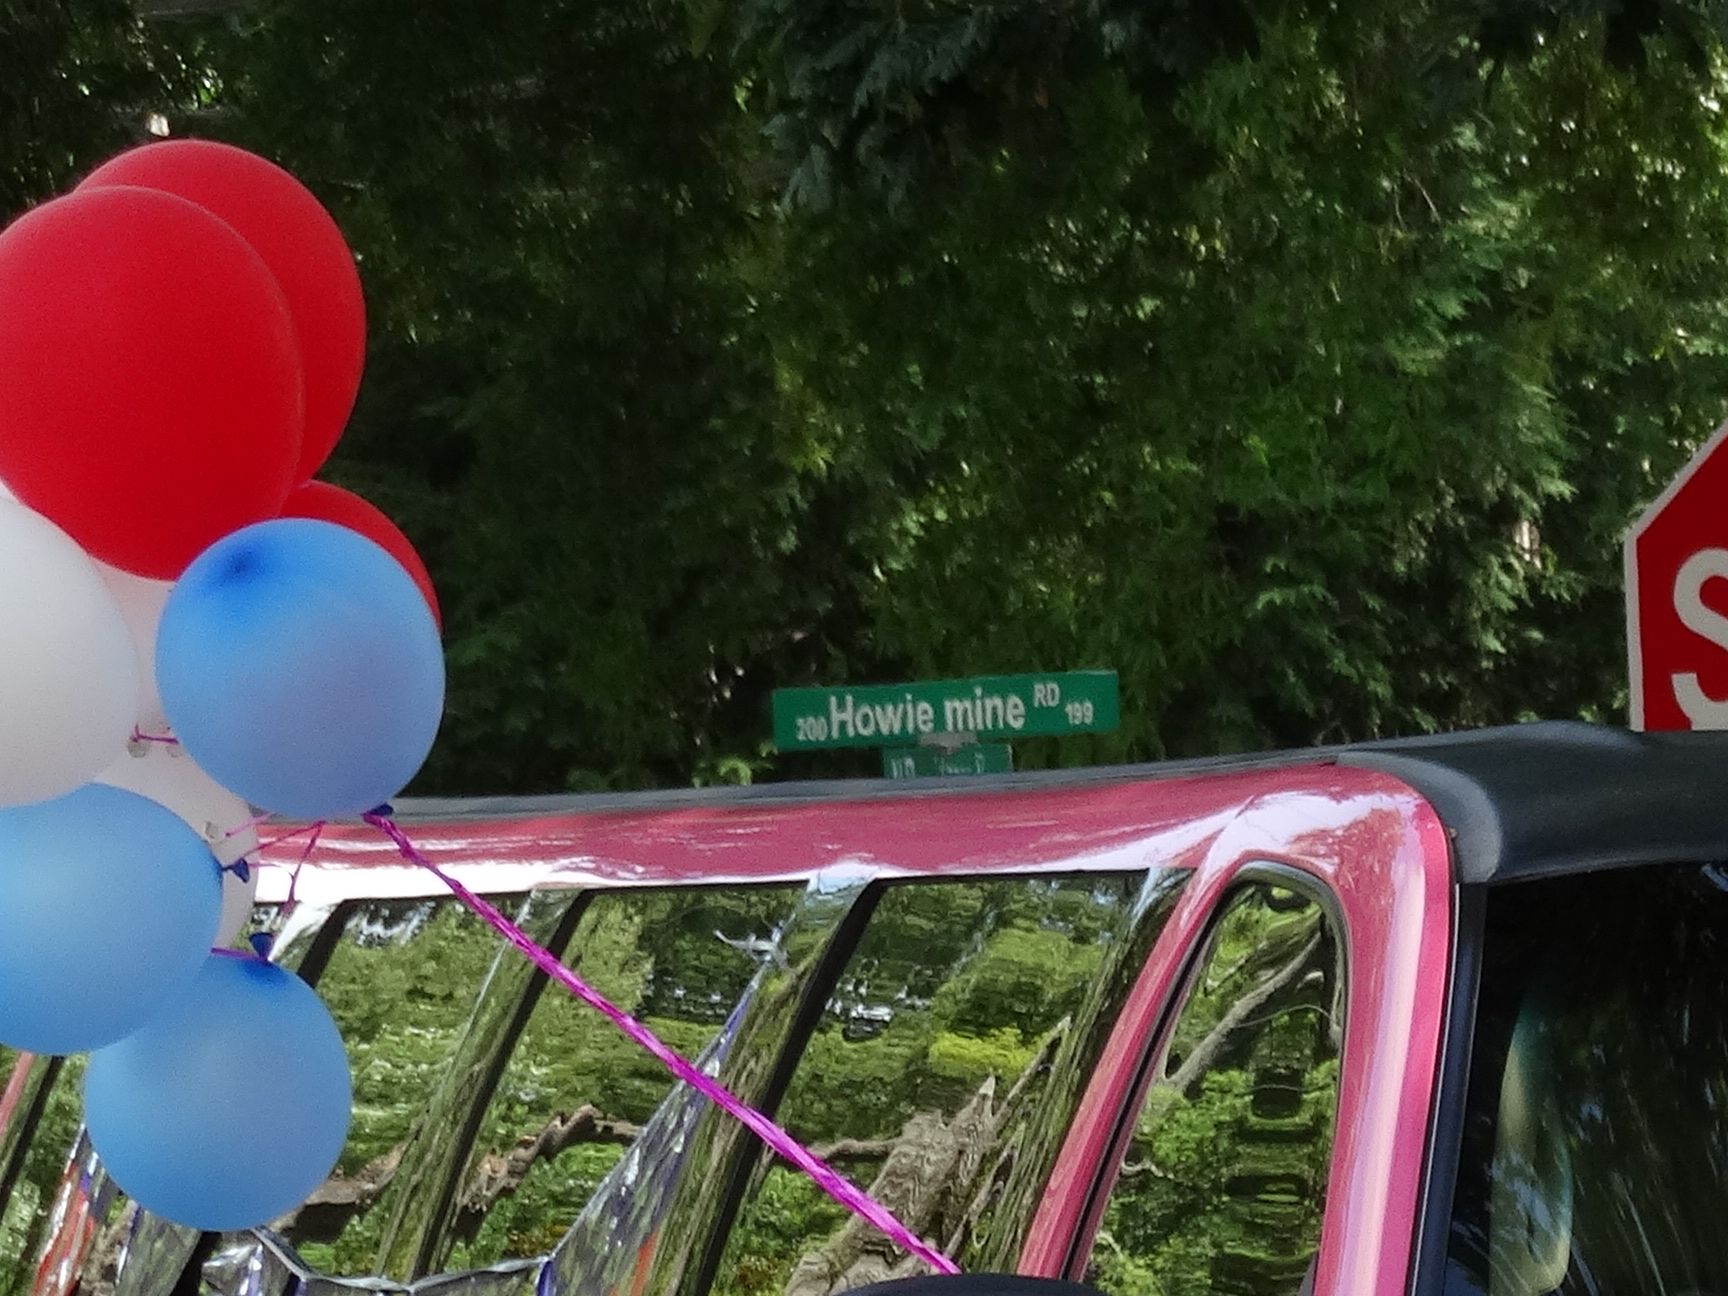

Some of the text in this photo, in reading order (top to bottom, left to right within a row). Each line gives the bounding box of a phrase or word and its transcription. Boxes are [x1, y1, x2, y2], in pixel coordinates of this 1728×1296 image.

[796, 682, 1094, 741] 200 Howie mine RD 199
